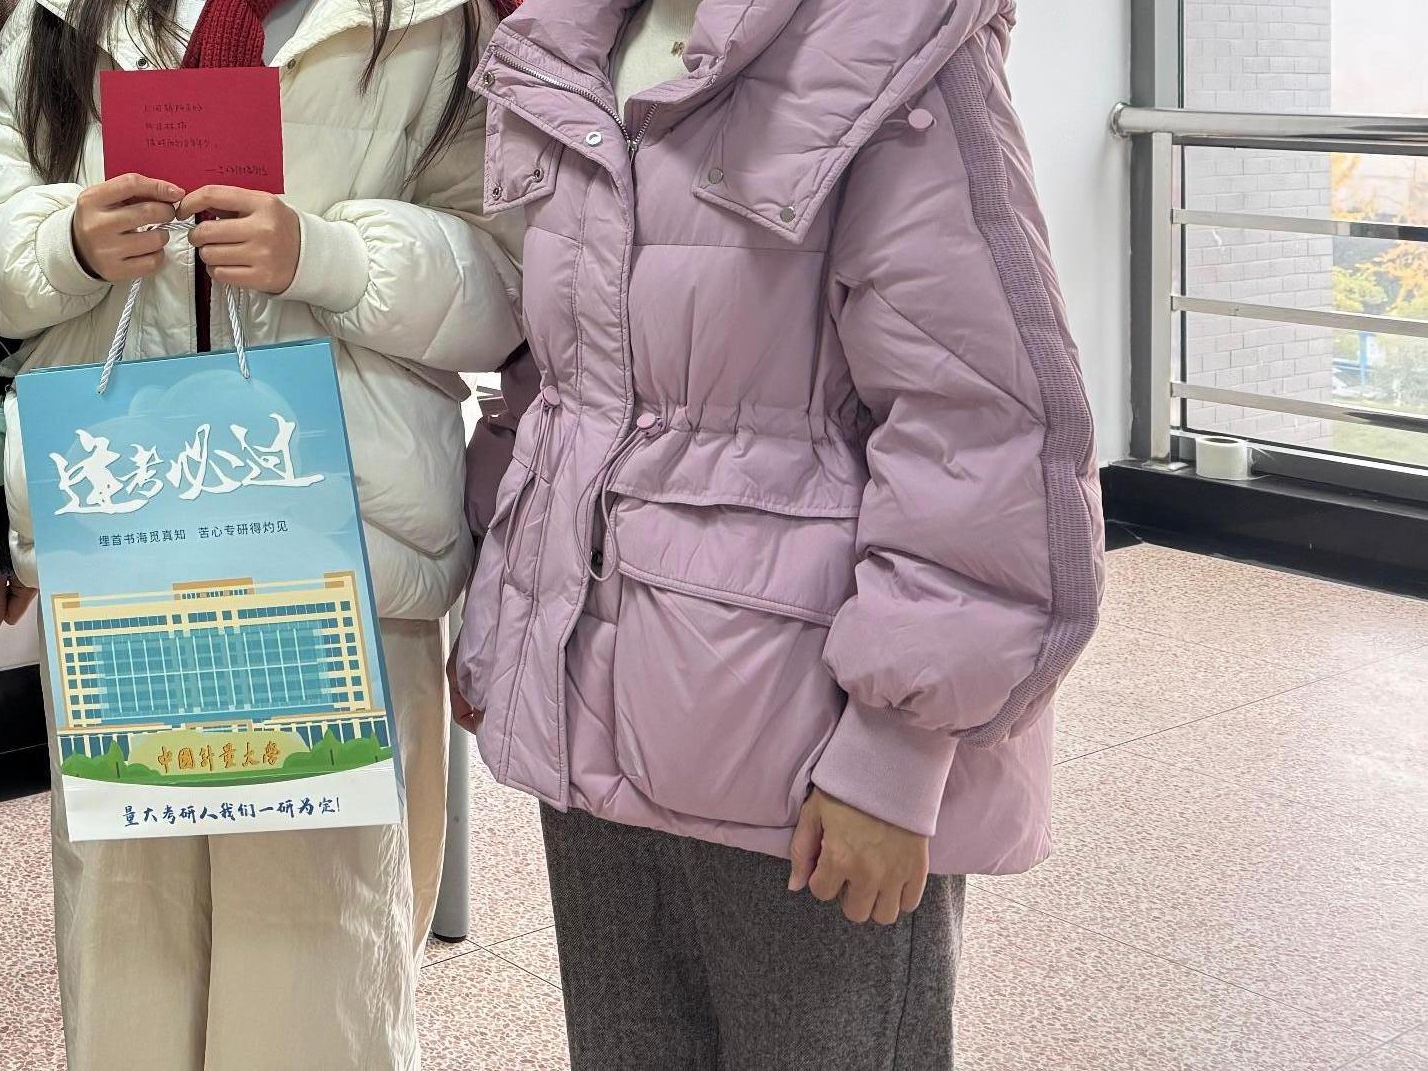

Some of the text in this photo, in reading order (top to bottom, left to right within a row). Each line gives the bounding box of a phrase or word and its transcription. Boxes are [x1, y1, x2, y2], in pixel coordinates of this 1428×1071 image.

[98, 520, 289, 547] 埋首书海觅真知 苦心专研得灼见
